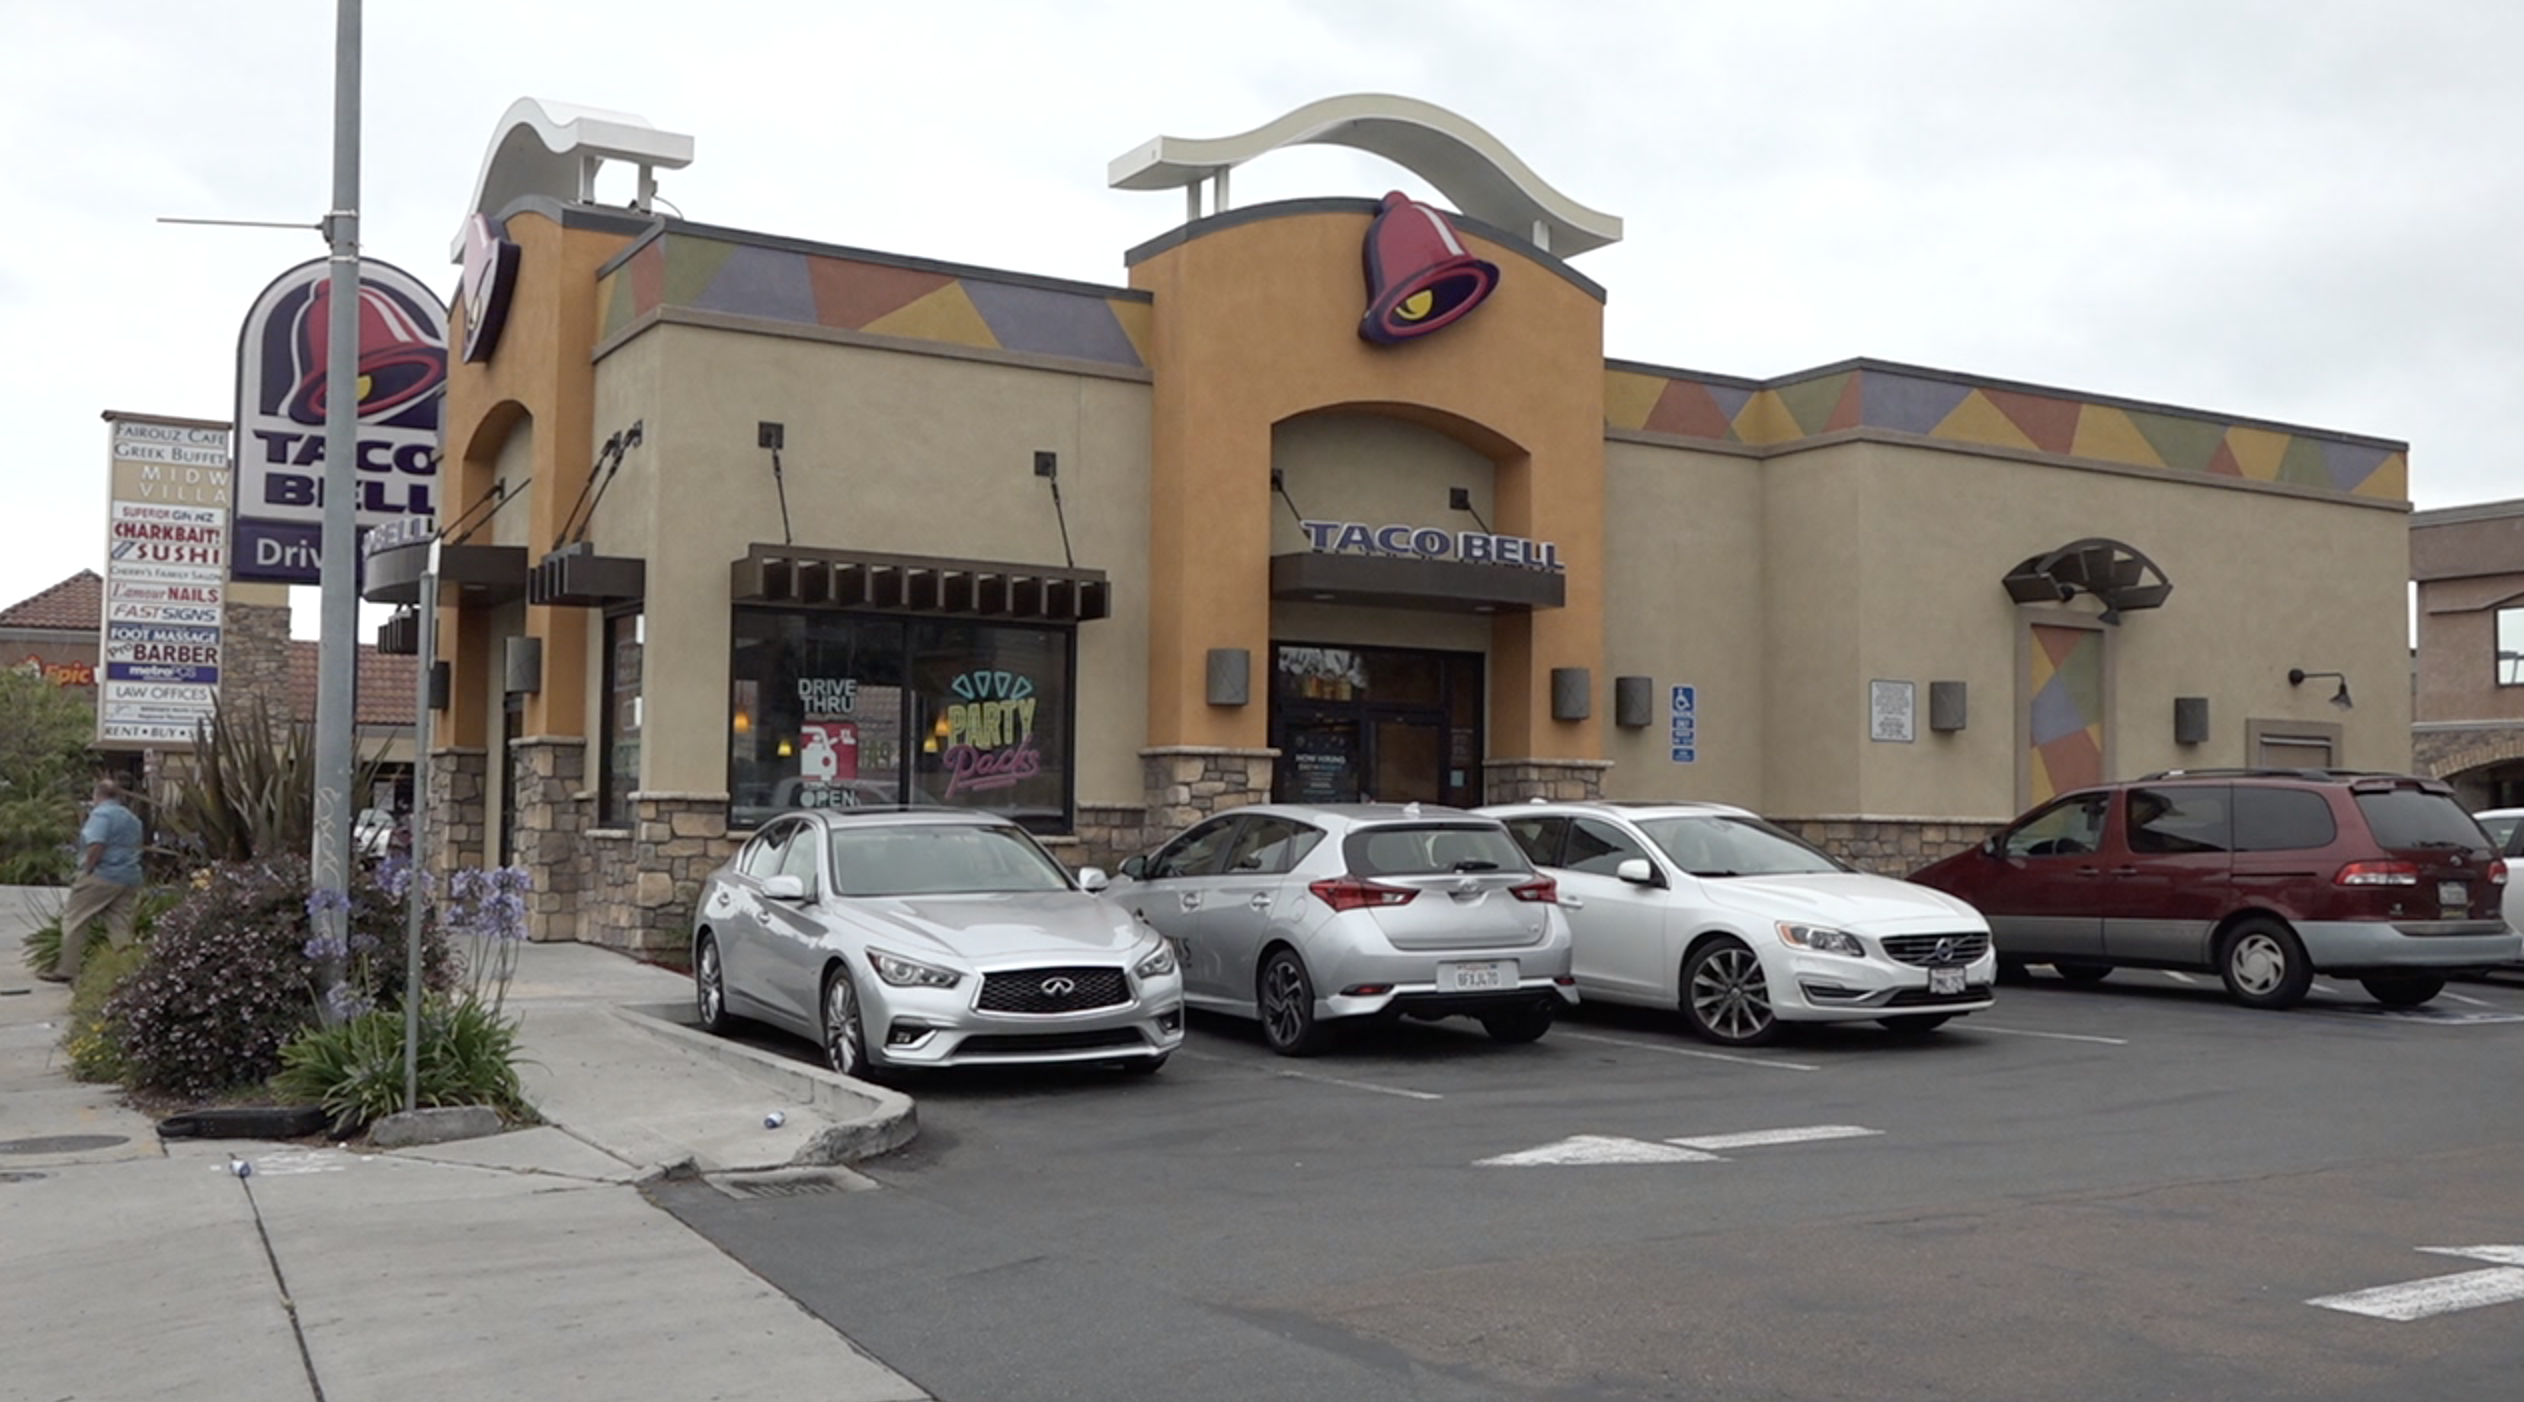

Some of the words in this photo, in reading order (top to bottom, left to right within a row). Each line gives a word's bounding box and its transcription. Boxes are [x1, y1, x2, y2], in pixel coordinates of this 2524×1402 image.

[116, 421, 182, 441] FAIROUZ
[114, 442, 165, 460] GREEK
[172, 447, 225, 465] BUFFET
[265, 472, 435, 516] BLL
[115, 522, 221, 545] CHARKBAIT!
[137, 543, 219, 565] SUSHI
[1300, 519, 1452, 558] TACO
[1457, 531, 1567, 571] BELL
[167, 587, 219, 603] NAILS
[111, 627, 150, 641] FOOT
[152, 630, 217, 645] MASSAGE
[133, 643, 218, 664] BARBER
[116, 685, 149, 699] LAW
[150, 686, 208, 701] OFFICES
[798, 679, 857, 696] DRIVE
[800, 695, 856, 713] THRU
[104, 726, 140, 737] RENT
[150, 727, 177, 738] BUY
[948, 698, 1036, 751] PARTY
[943, 732, 1040, 800] Packs
[800, 790, 856, 808] OPEN
